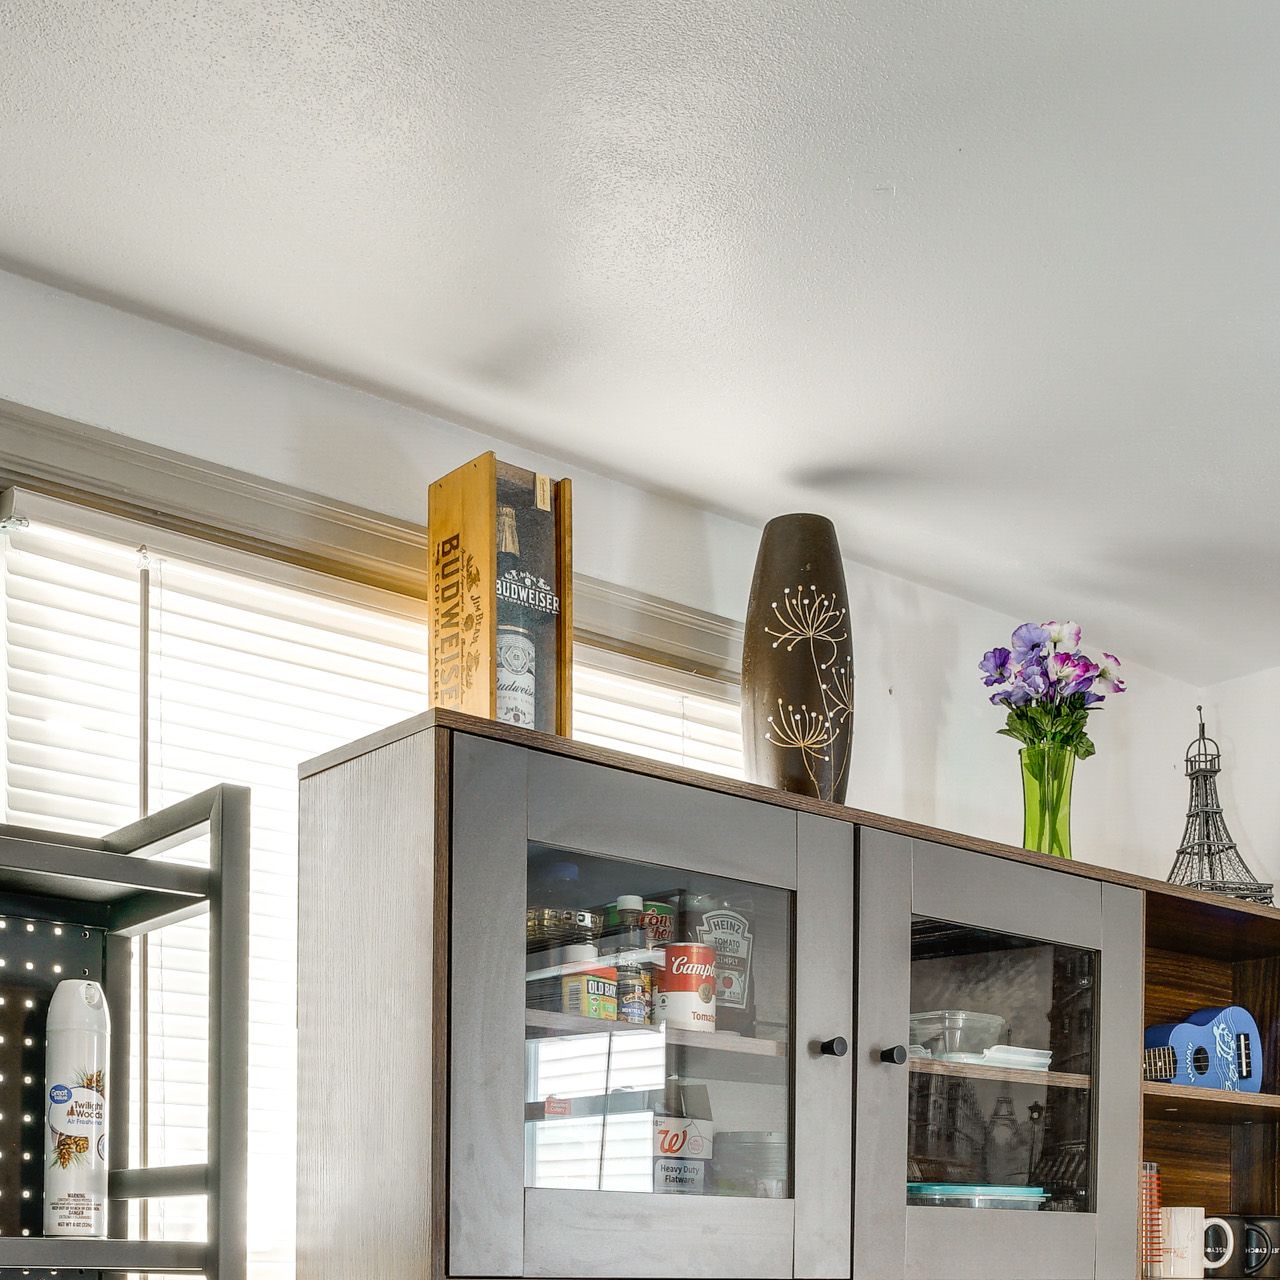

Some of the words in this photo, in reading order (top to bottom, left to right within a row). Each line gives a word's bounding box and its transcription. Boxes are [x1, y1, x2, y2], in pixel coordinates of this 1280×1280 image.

[441, 533, 460, 709] BUDWEISE
[712, 919, 742, 935] HEINZ
[588, 980, 604, 995] OLD
[604, 983, 617, 998] BAY
[1185, 1042, 1195, 1082] HAWAII
[74, 1100, 103, 1111] Twilight
[75, 1110, 103, 1119] Woods
[660, 1164, 683, 1174] Heavy
[684, 1165, 700, 1175] Duty
[665, 1174, 695, 1184] Flatware
